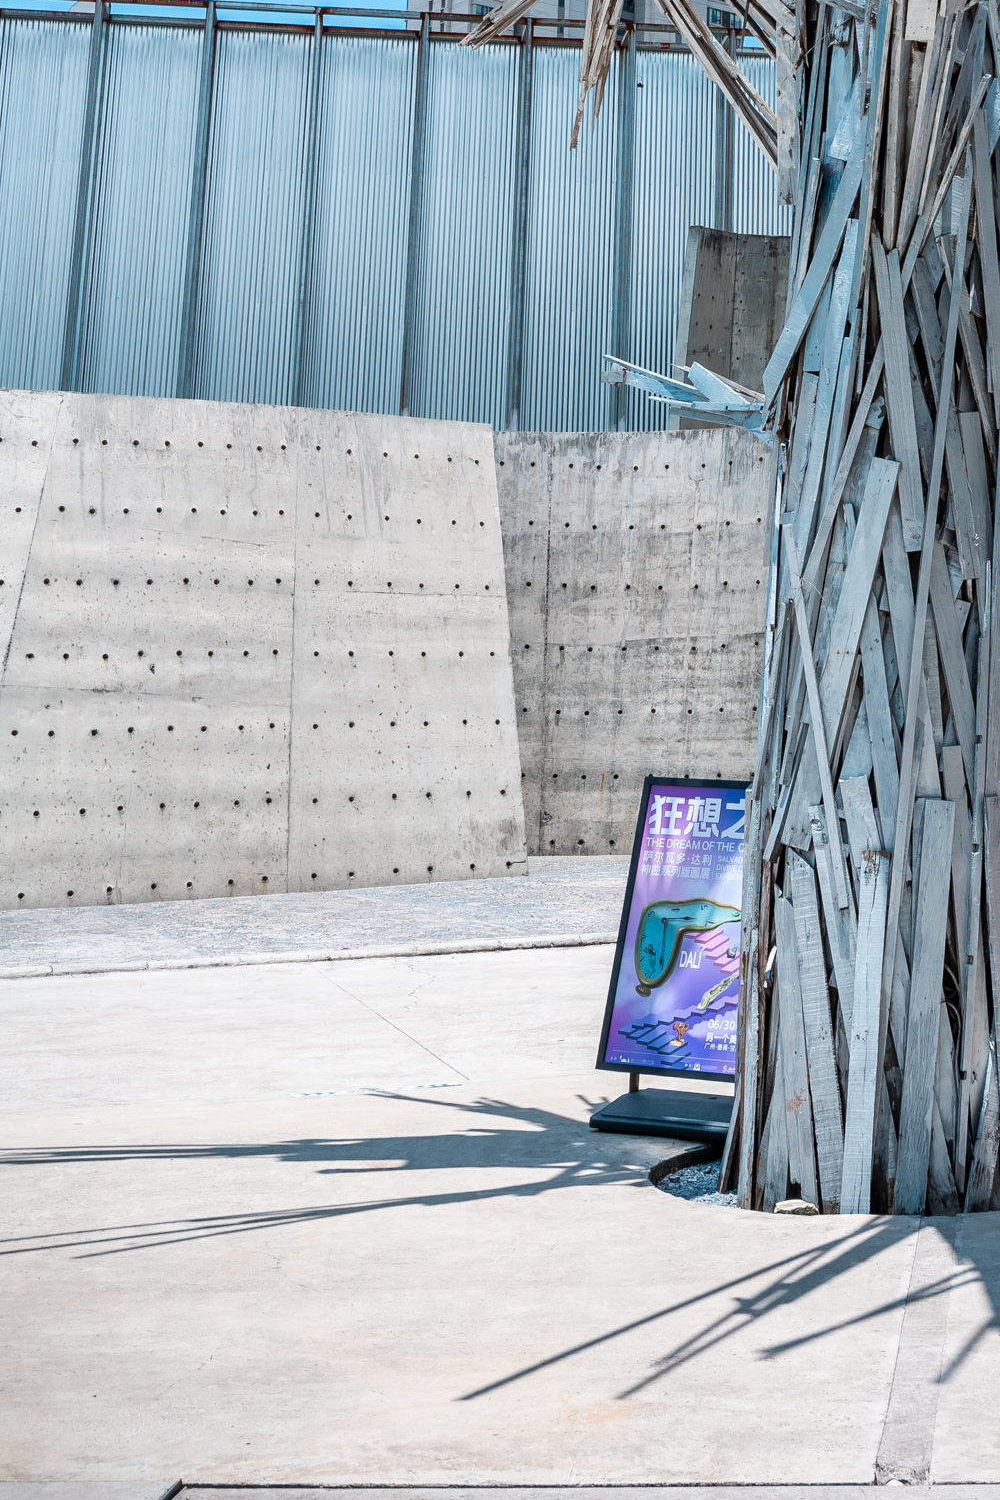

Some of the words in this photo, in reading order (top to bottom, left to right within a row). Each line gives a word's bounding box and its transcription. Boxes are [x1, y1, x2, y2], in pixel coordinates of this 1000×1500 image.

[649, 795, 745, 839] 狂想之
[646, 837, 664, 848] THE
[666, 838, 700, 850] DREAM
[702, 841, 715, 851] OF
[716, 841, 735, 852] THE
[643, 850, 712, 866] 萨尔瓦多·达利
[641, 863, 710, 879] 神曲系列版画展
[679, 947, 705, 969] DALÍ
[708, 1018, 735, 1030] 06/30
